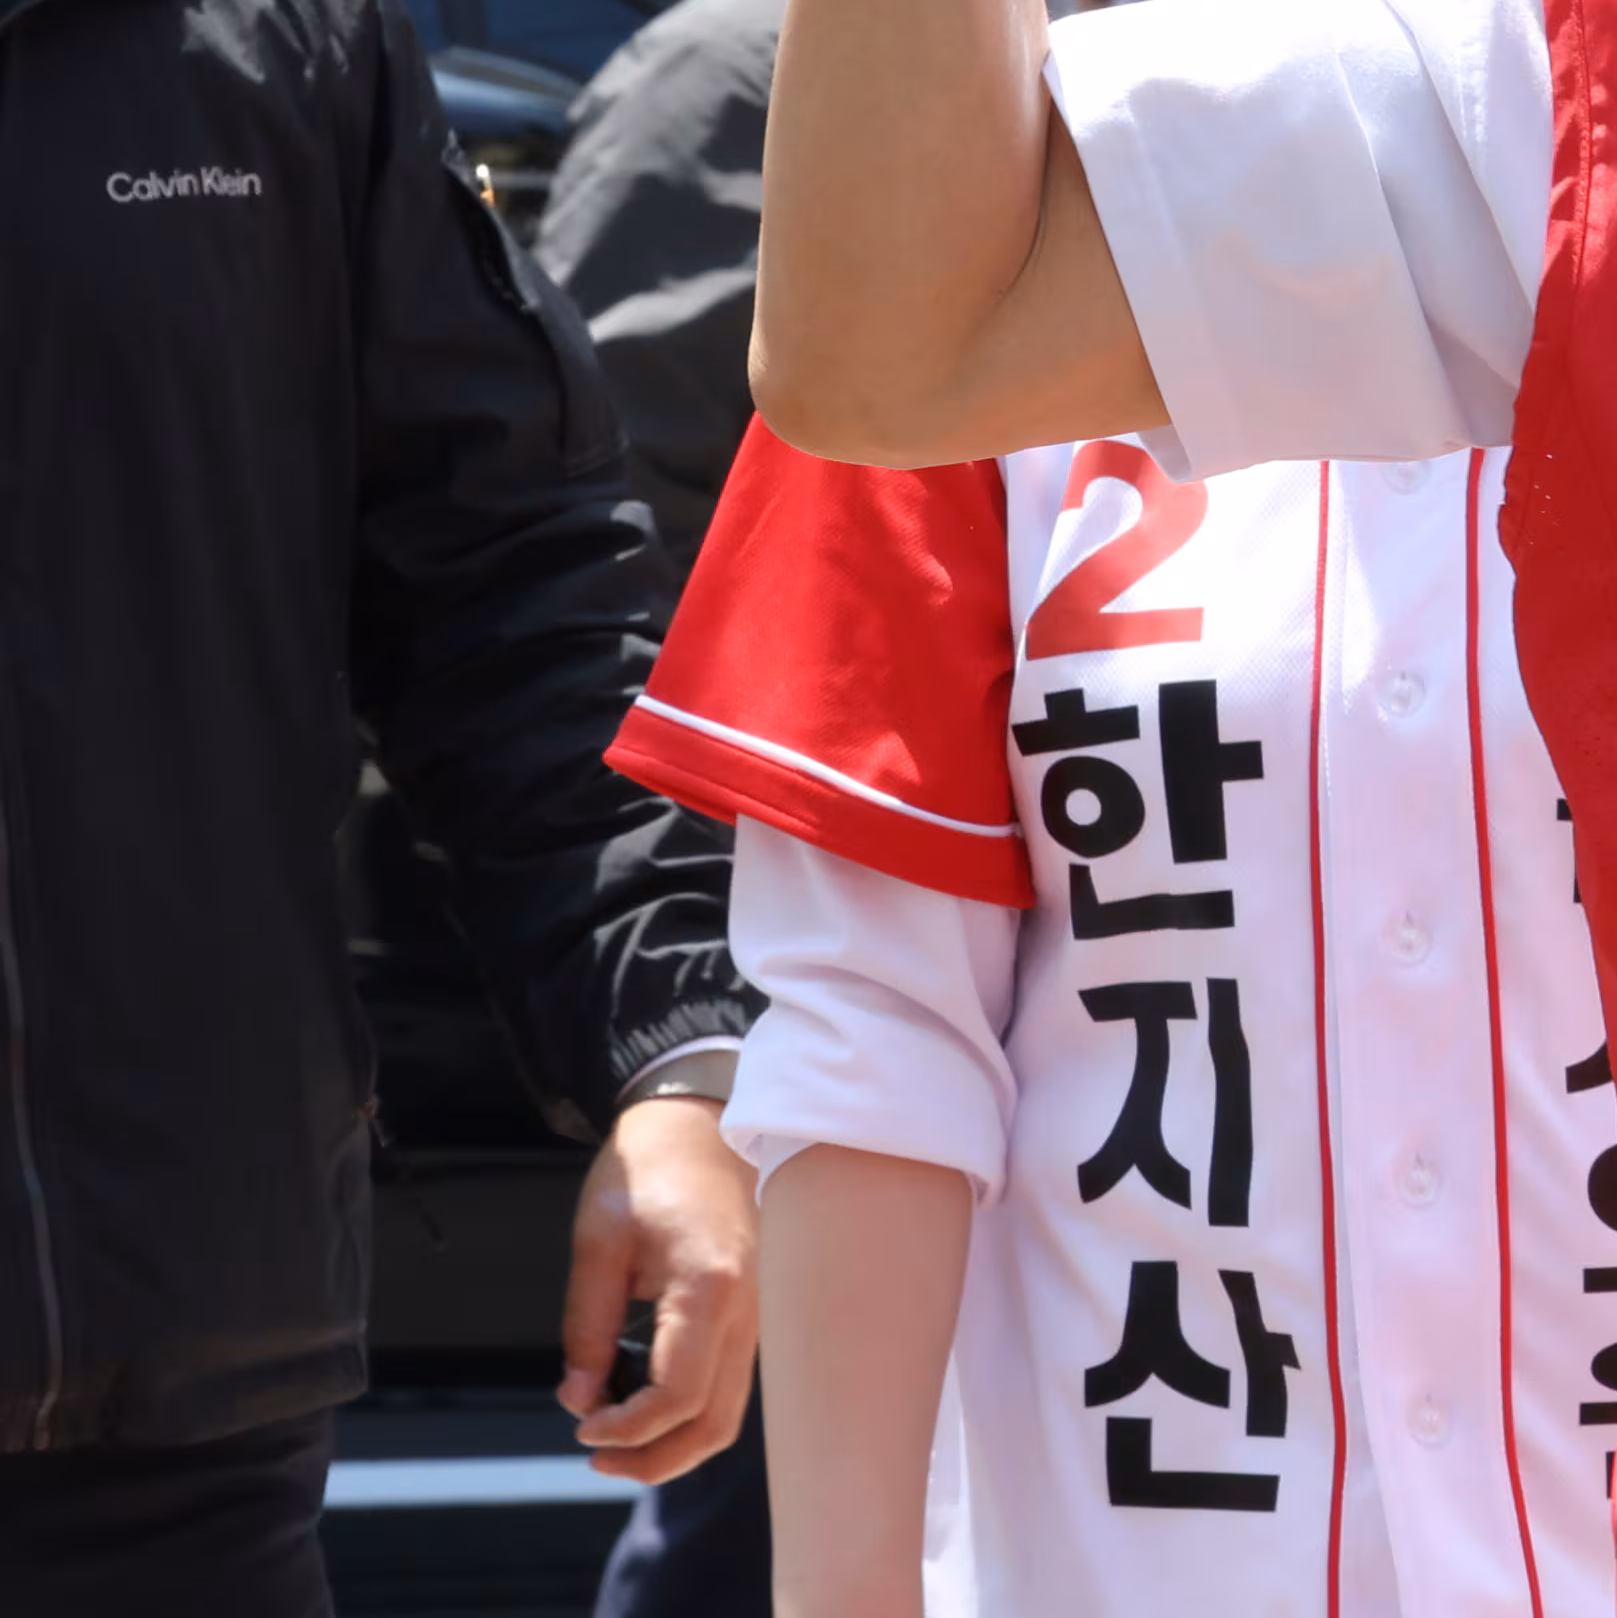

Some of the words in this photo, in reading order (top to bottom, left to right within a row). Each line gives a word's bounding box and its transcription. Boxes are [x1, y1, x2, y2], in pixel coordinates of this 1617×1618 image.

[107, 167, 199, 203] Calvin
[201, 165, 262, 199] Klein
[1026, 439, 1209, 661] 2
[1011, 678, 1301, 1513] 한지산
